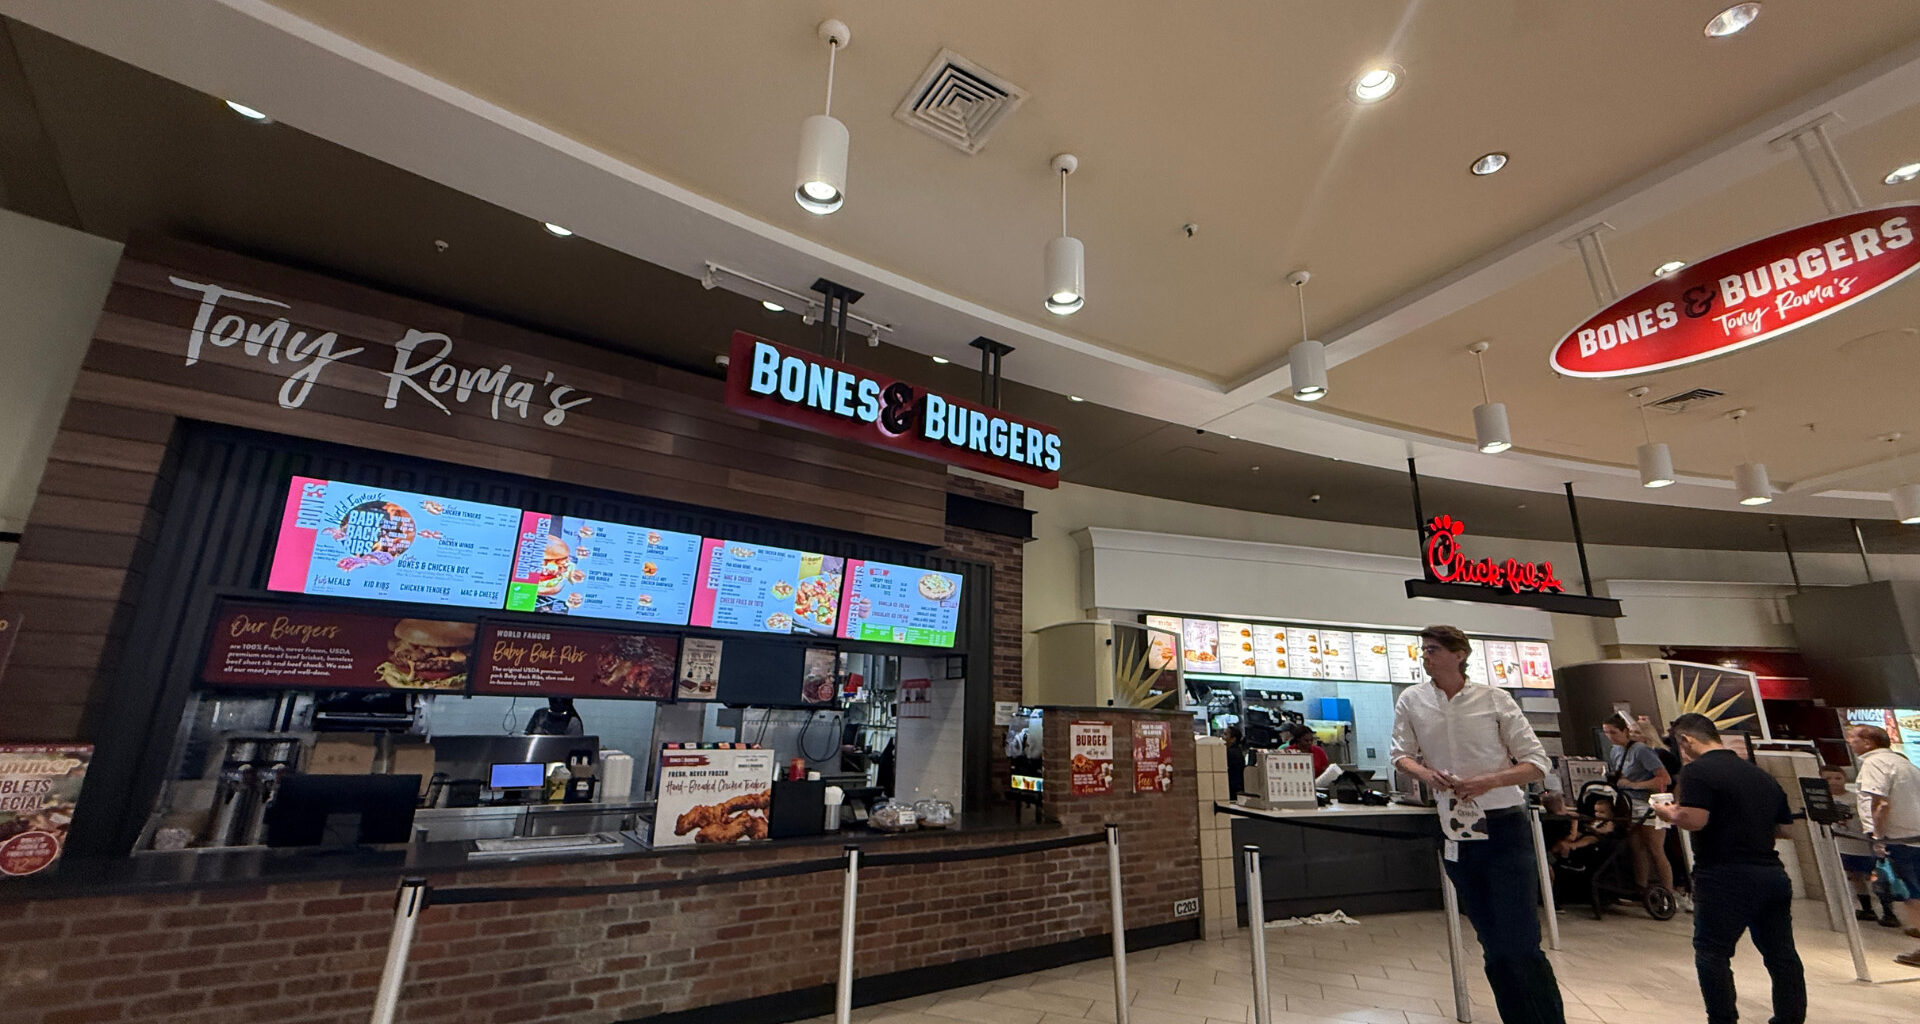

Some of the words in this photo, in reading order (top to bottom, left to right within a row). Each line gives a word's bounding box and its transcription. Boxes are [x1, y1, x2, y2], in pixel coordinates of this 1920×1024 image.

[1576, 300, 1678, 358] BONES
[1682, 284, 1716, 319] &
[1718, 216, 1915, 308] BURGERS
[1712, 305, 1770, 337] Tony
[1774, 274, 1858, 320] Roma's
[168, 275, 365, 410] Tony
[379, 328, 592, 427] Roma's
[750, 341, 880, 423] BONES
[877, 382, 914, 438] &
[924, 393, 1062, 471] BURGERS
[295, 482, 328, 530] BONES
[324, 501, 347, 524] World
[347, 493, 385, 506] Famous
[348, 510, 384, 526] BABY
[462, 512, 481, 520] TENDERS
[346, 524, 382, 541] BACK
[344, 540, 373, 556] RIBS
[530, 518, 550, 574] SANDWICHES
[398, 560, 420, 570] BONES
[421, 562, 426, 570] &
[428, 562, 455, 573] CHICKEN
[456, 565, 470, 574] BOX
[516, 540, 534, 579] BURGERS
[1428, 530, 1566, 594] Chick-fil-A
[328, 577, 351, 586] MEALS
[376, 581, 390, 590] RIBS
[400, 583, 424, 592] CHICKEN
[426, 584, 451, 595] TENDERS
[461, 588, 472, 596] MAC
[478, 590, 499, 600] CHEESE
[230, 614, 268, 637] Our
[271, 616, 342, 643] Burgers
[497, 630, 522, 638] WORLD
[524, 632, 551, 640] FAMOUS
[492, 640, 528, 666] Baby
[530, 642, 557, 663] Back
[560, 645, 588, 665] Ribs
[264, 668, 282, 676] juicy
[1076, 734, 1107, 746] BURGER
[0, 779, 52, 794] BLETS
[666, 778, 716, 796] Hand-Breaded
[718, 778, 743, 792] Chicken
[744, 778, 768, 792] Tenders
[1176, 901, 1196, 915] C203
